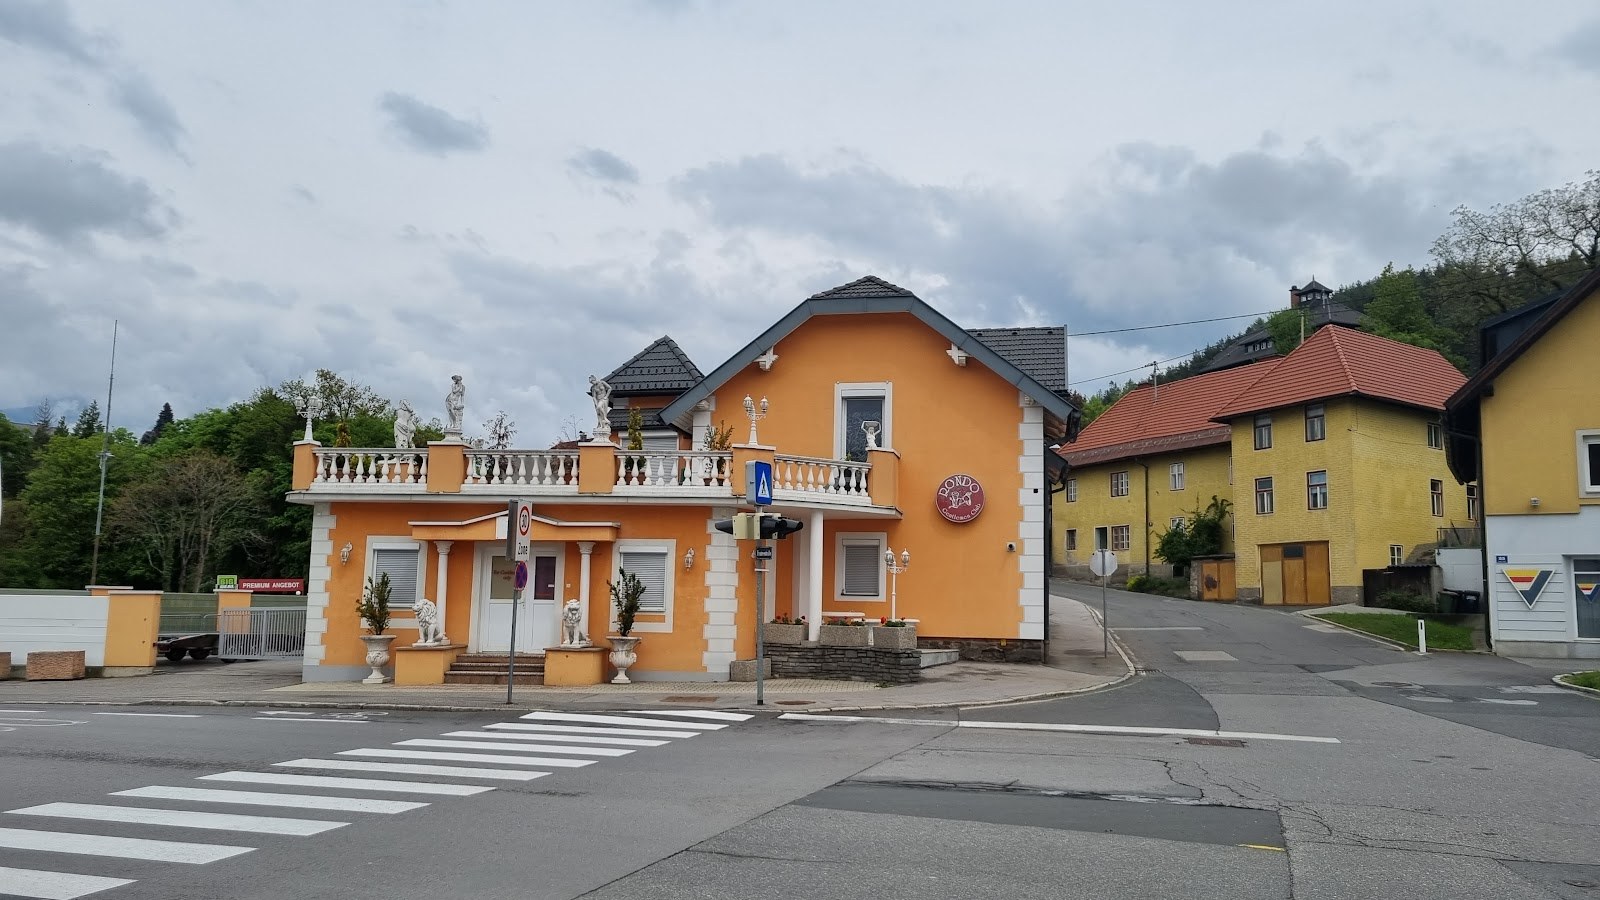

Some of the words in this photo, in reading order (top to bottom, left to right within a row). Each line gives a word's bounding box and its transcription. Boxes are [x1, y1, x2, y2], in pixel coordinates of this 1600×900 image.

[938, 476, 980, 497] RONDO
[971, 503, 981, 516] Club
[521, 514, 528, 528] 30
[518, 542, 528, 555] Zone
